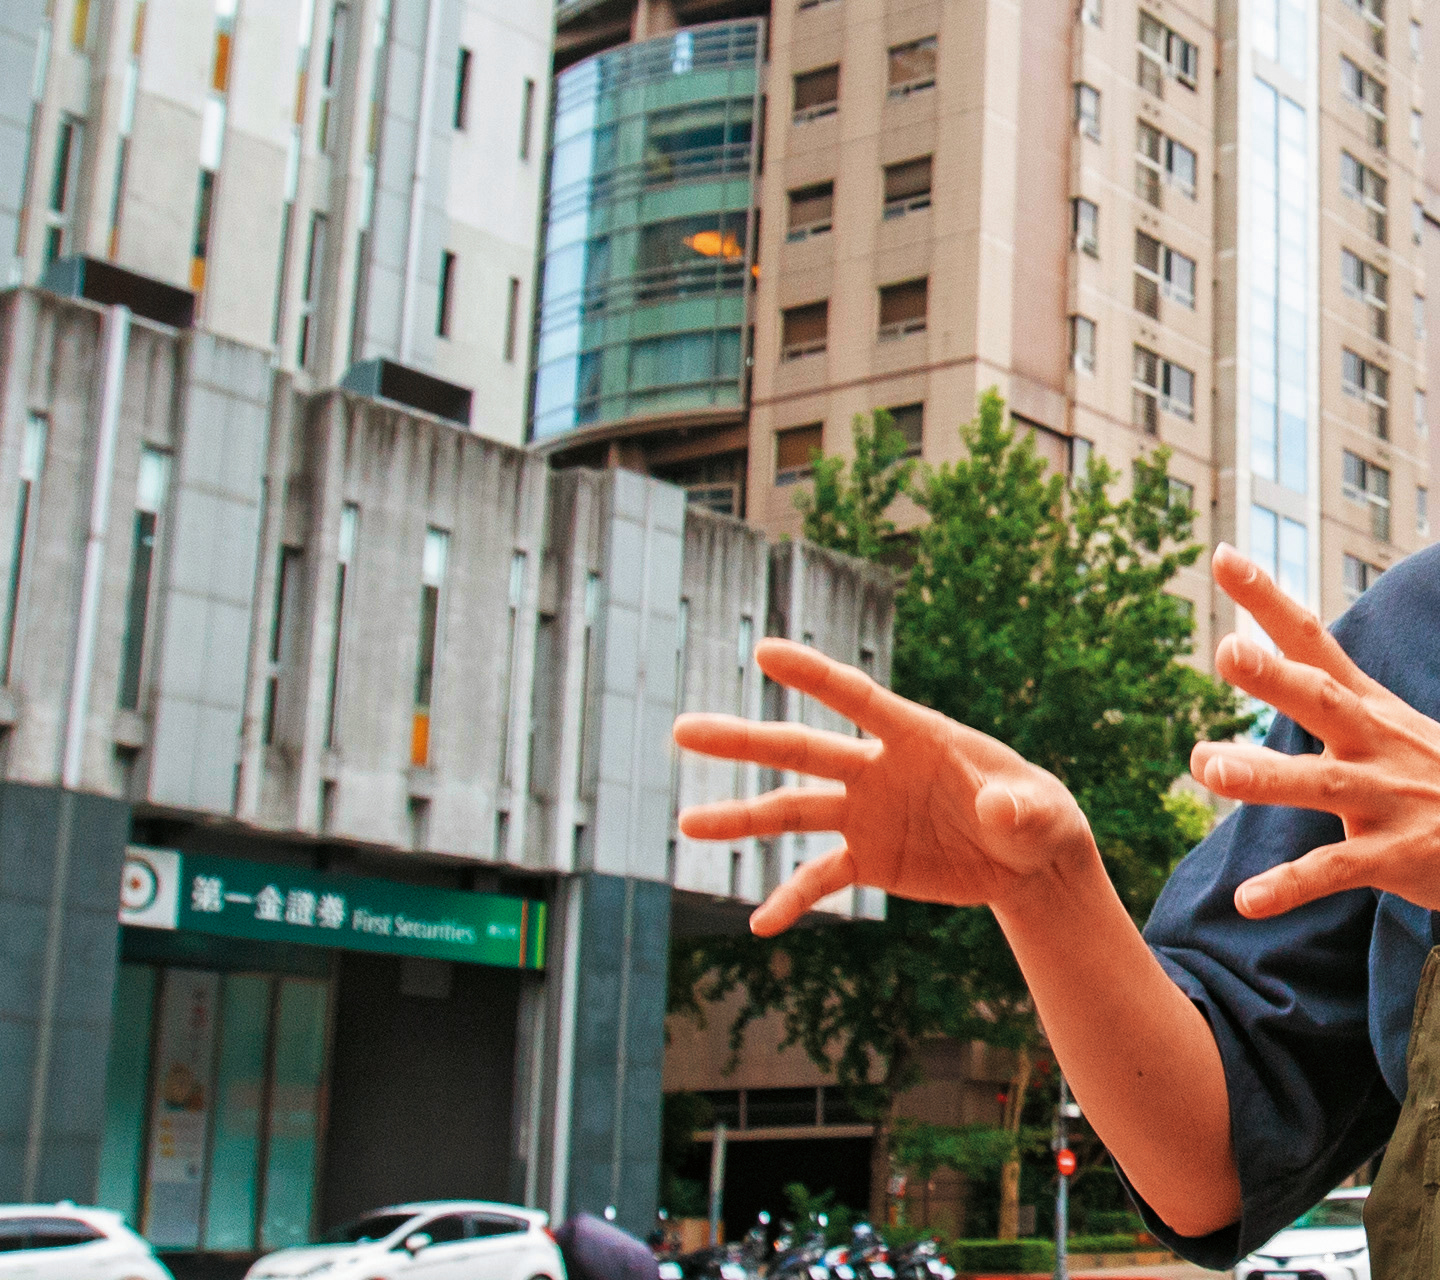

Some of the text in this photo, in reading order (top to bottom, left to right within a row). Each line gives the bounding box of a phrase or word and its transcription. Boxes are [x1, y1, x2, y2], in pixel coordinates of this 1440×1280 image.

[191, 874, 347, 931] 第一金證券
[351, 908, 393, 936] First
[394, 913, 476, 945] Securities
